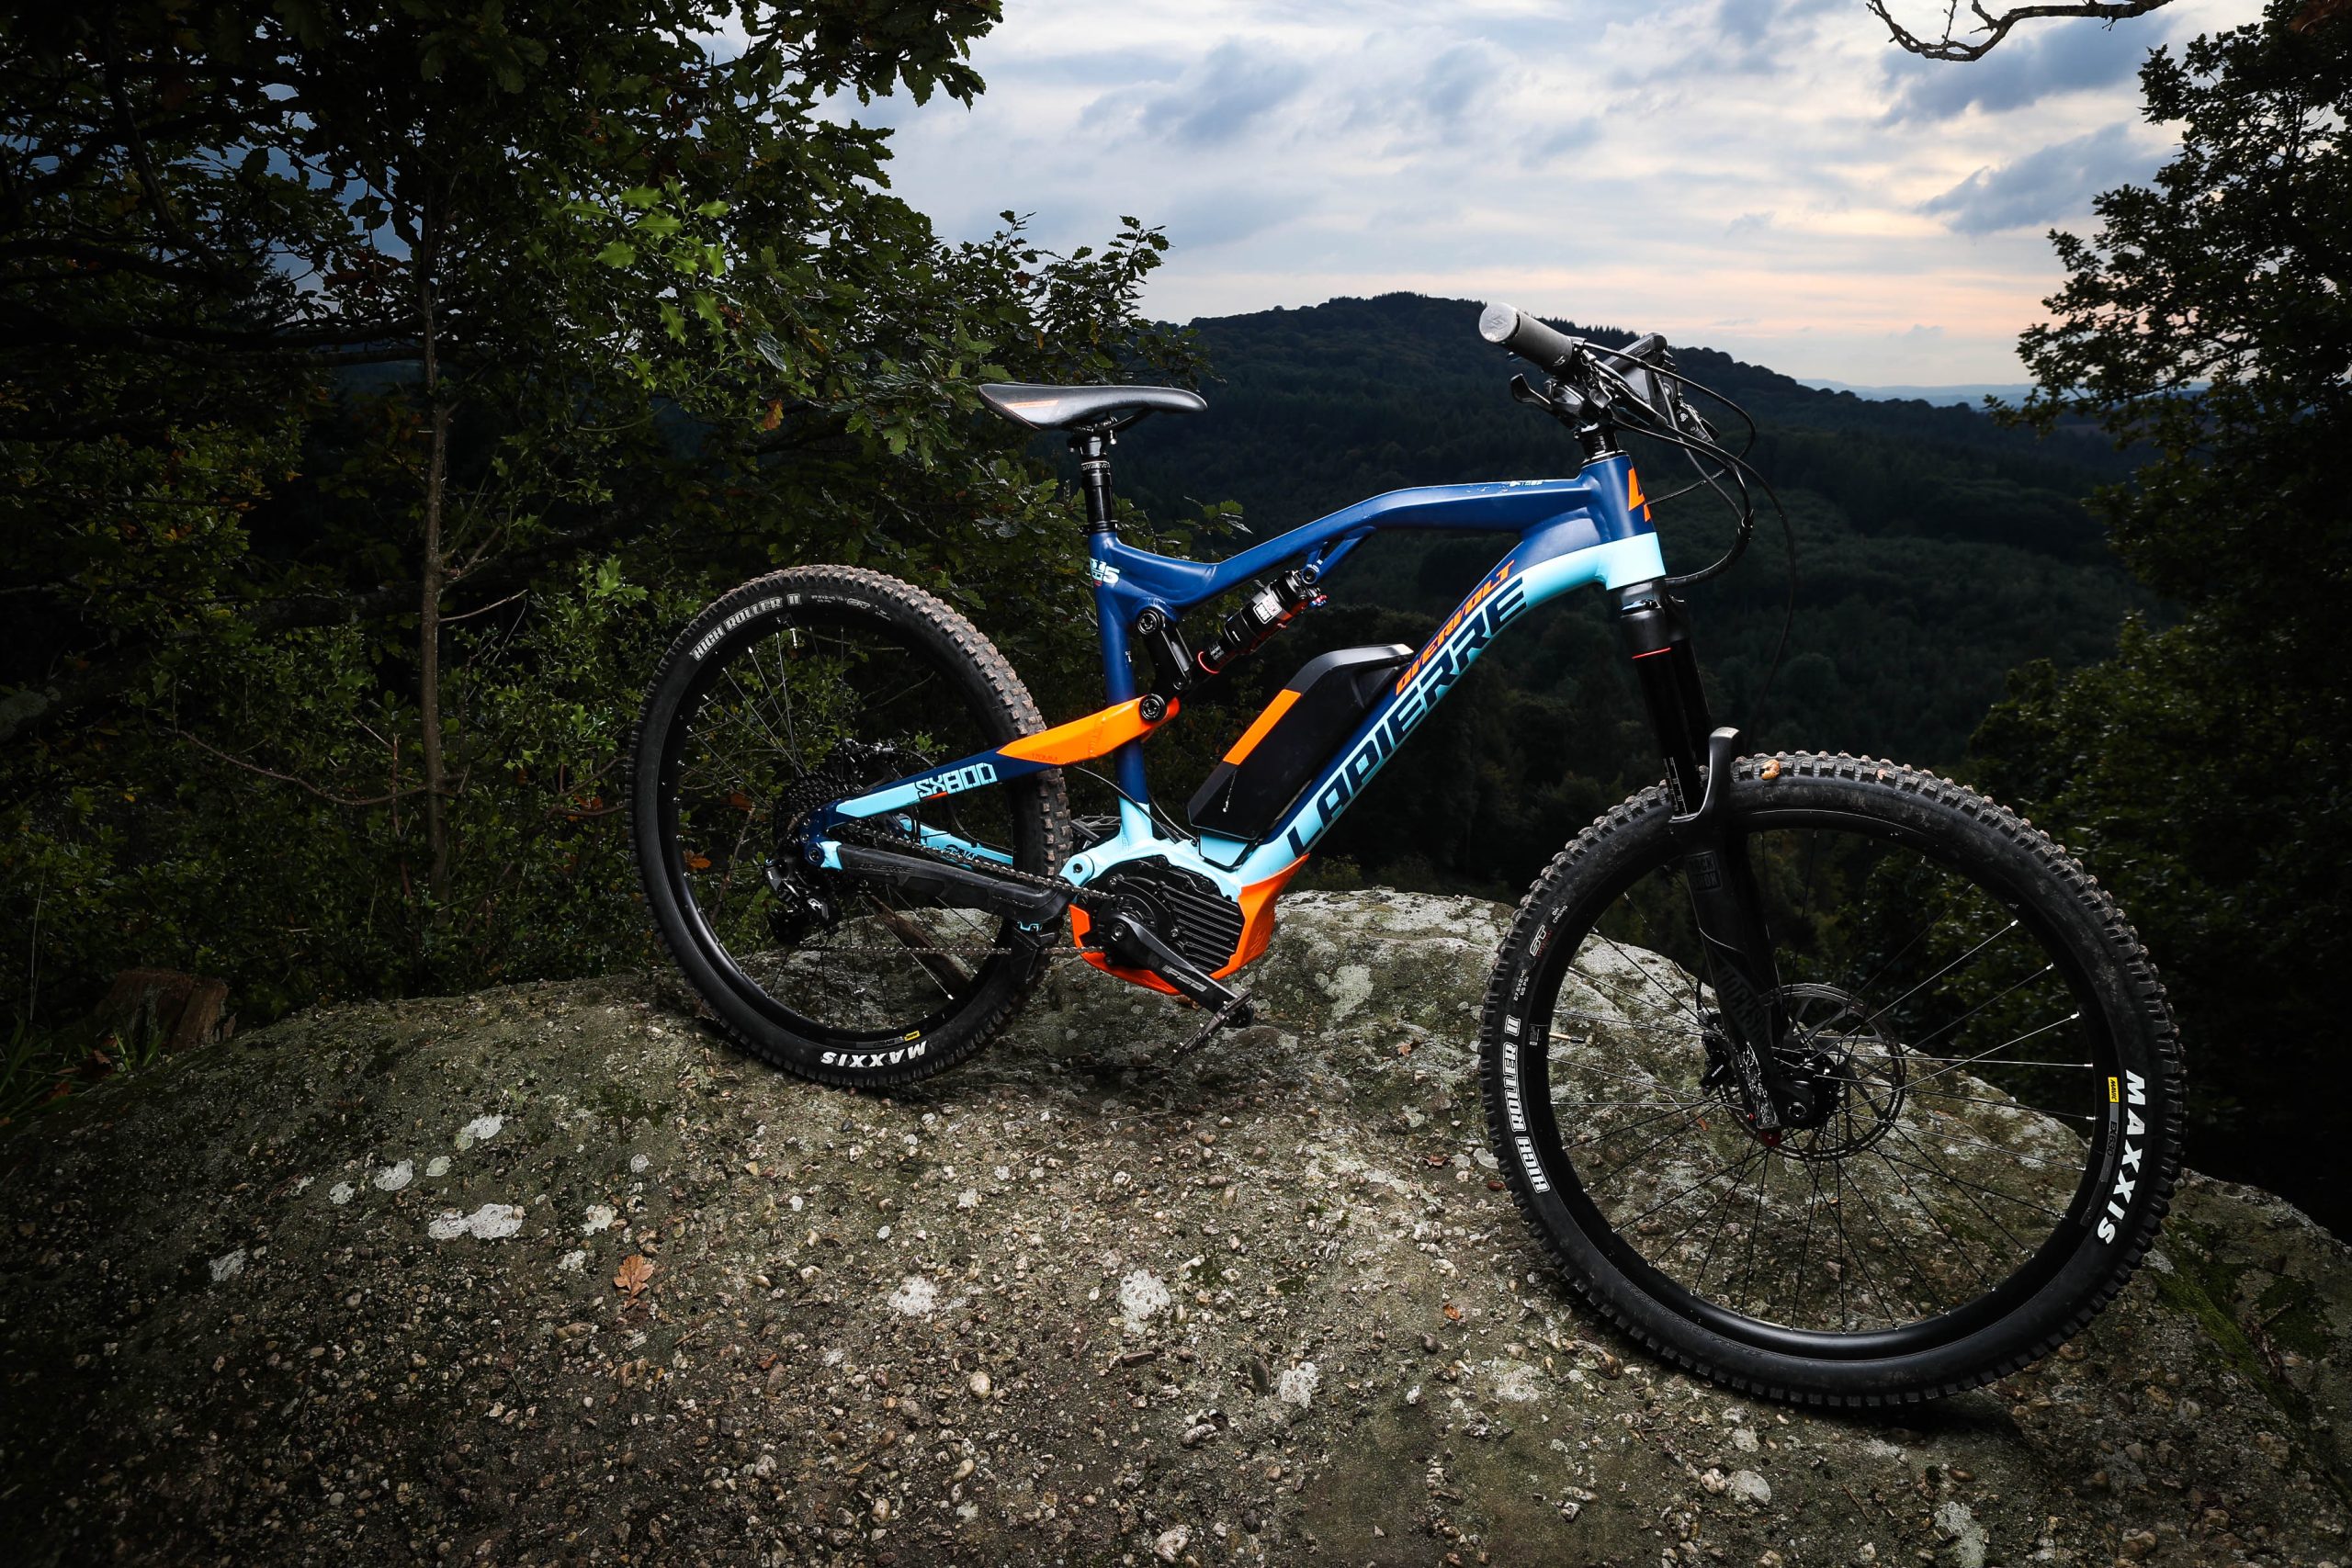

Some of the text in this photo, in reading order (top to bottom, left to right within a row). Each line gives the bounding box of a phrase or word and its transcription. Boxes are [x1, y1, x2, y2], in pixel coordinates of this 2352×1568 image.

[691, 625, 726, 660] HIGH
[723, 597, 783, 631] ROLLER
[1396, 559, 1514, 695] OVERVOLT
[1286, 576, 1527, 857] LAPIERRE
[914, 762, 998, 797] SX800
[820, 1040, 927, 1068] MAXXIS
[1503, 1042, 1527, 1132] ROLLER
[1515, 1136, 1550, 1193] HIGH
[2098, 1069, 2146, 1245] MAXXIS
